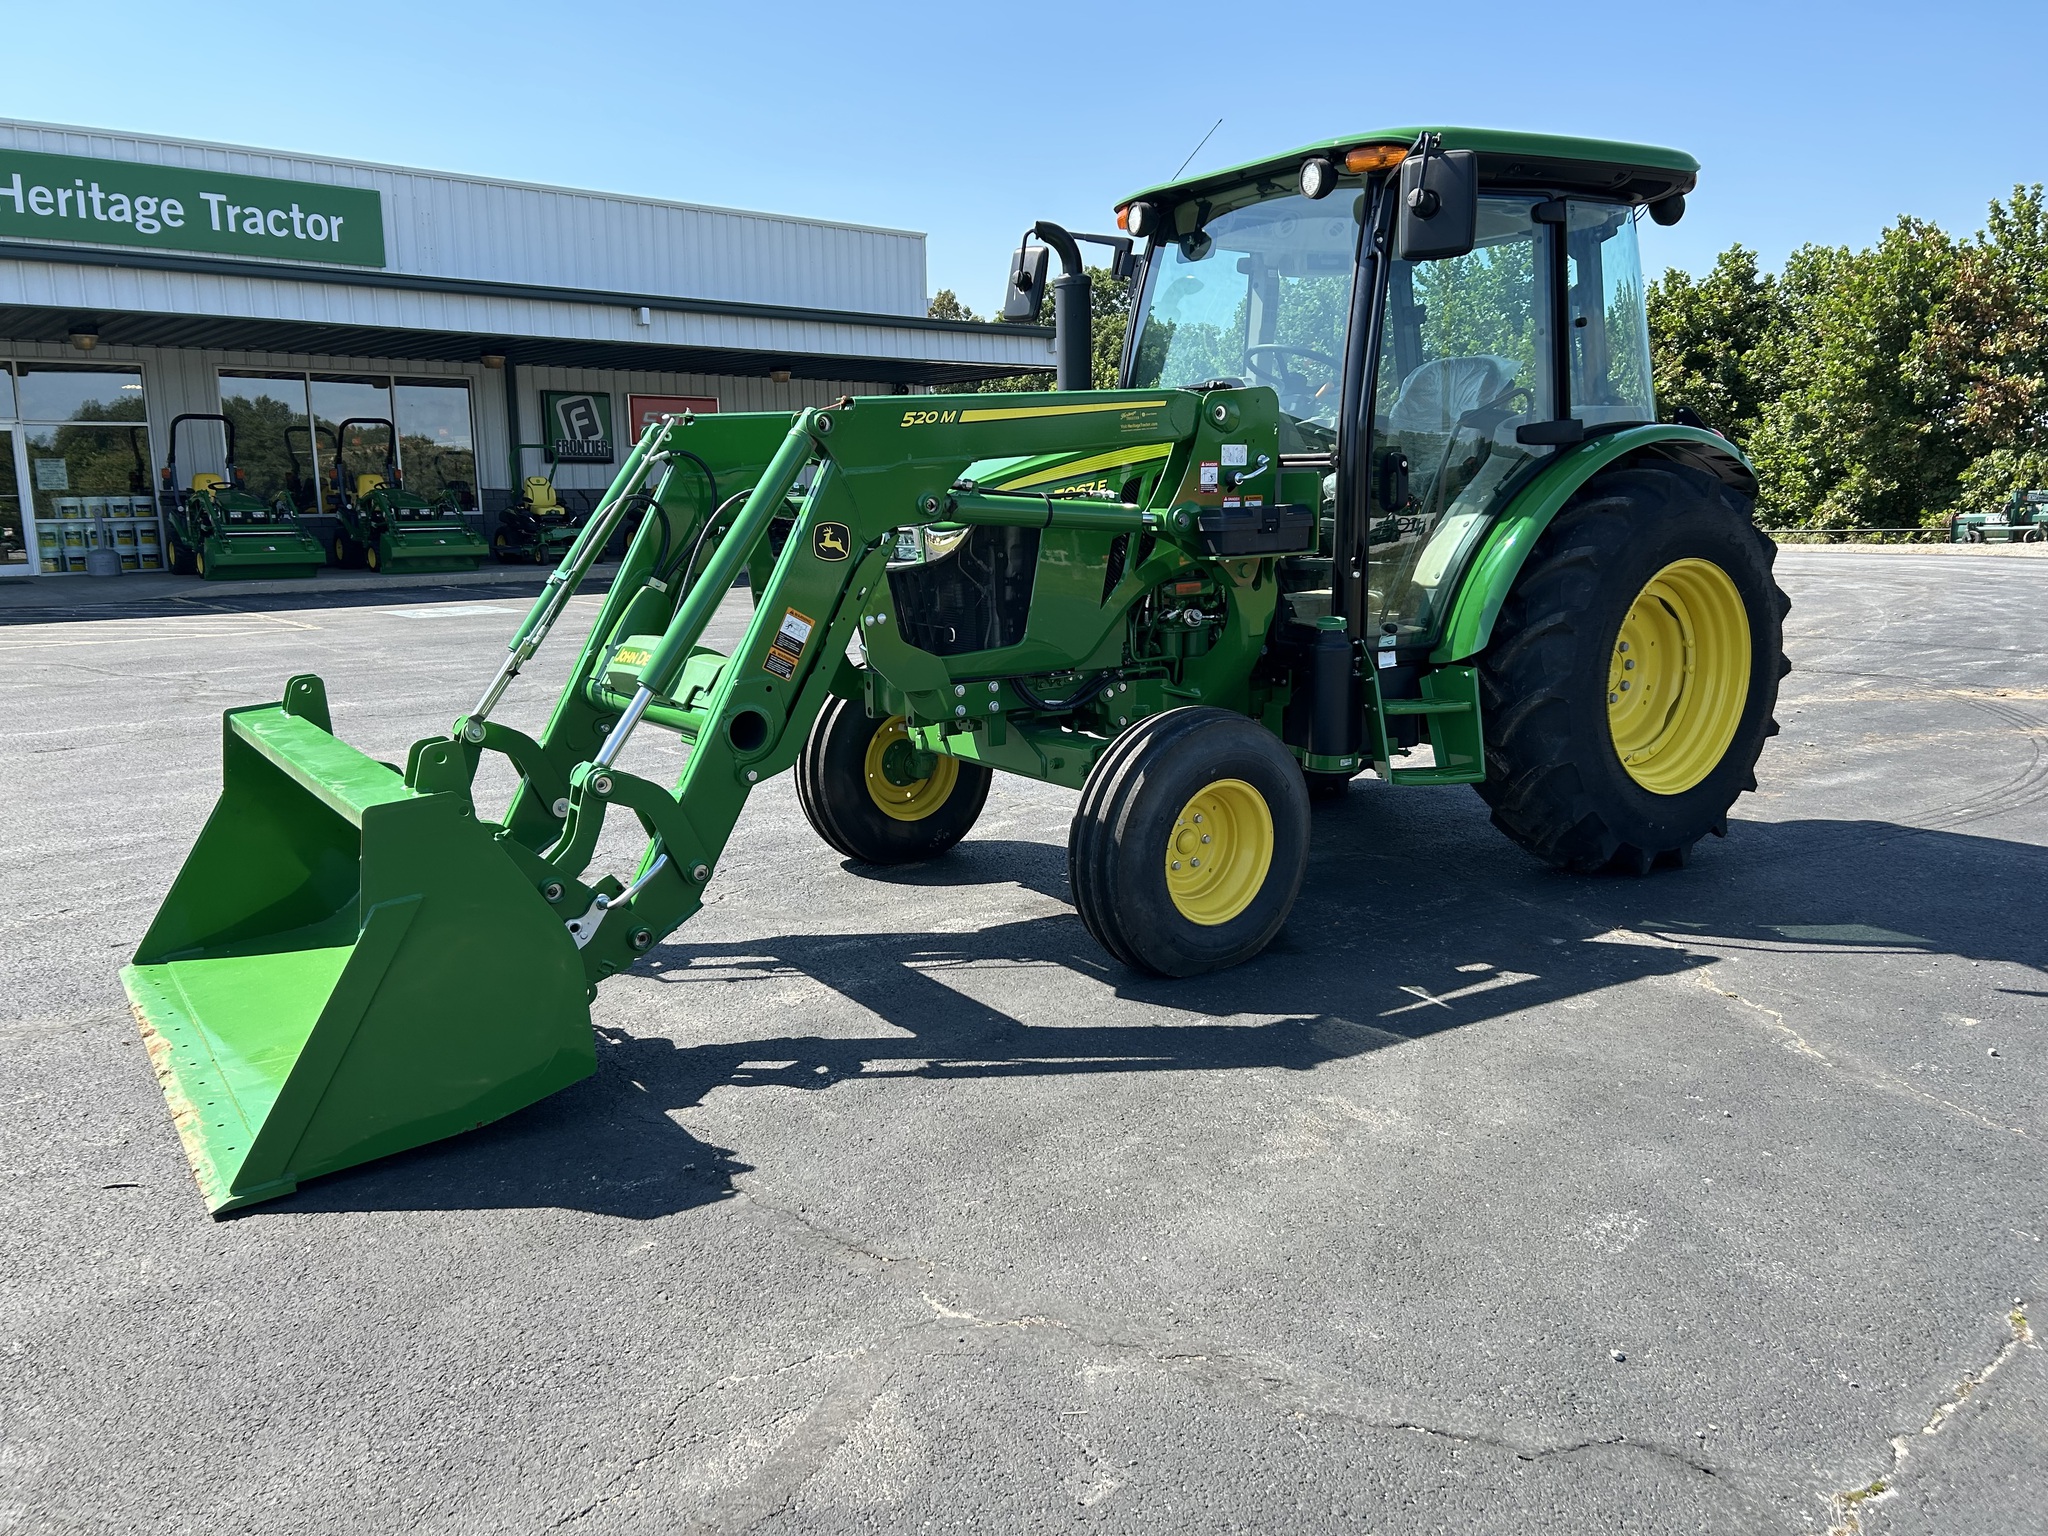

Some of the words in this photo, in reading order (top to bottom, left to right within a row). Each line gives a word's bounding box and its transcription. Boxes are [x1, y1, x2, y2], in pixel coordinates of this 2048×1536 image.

[0, 173, 185, 234] Heritage
[200, 191, 344, 242] Tractor
[900, 410, 939, 428] 520
[555, 439, 609, 456] FRONTIER
[614, 648, 640, 664] JOHN
